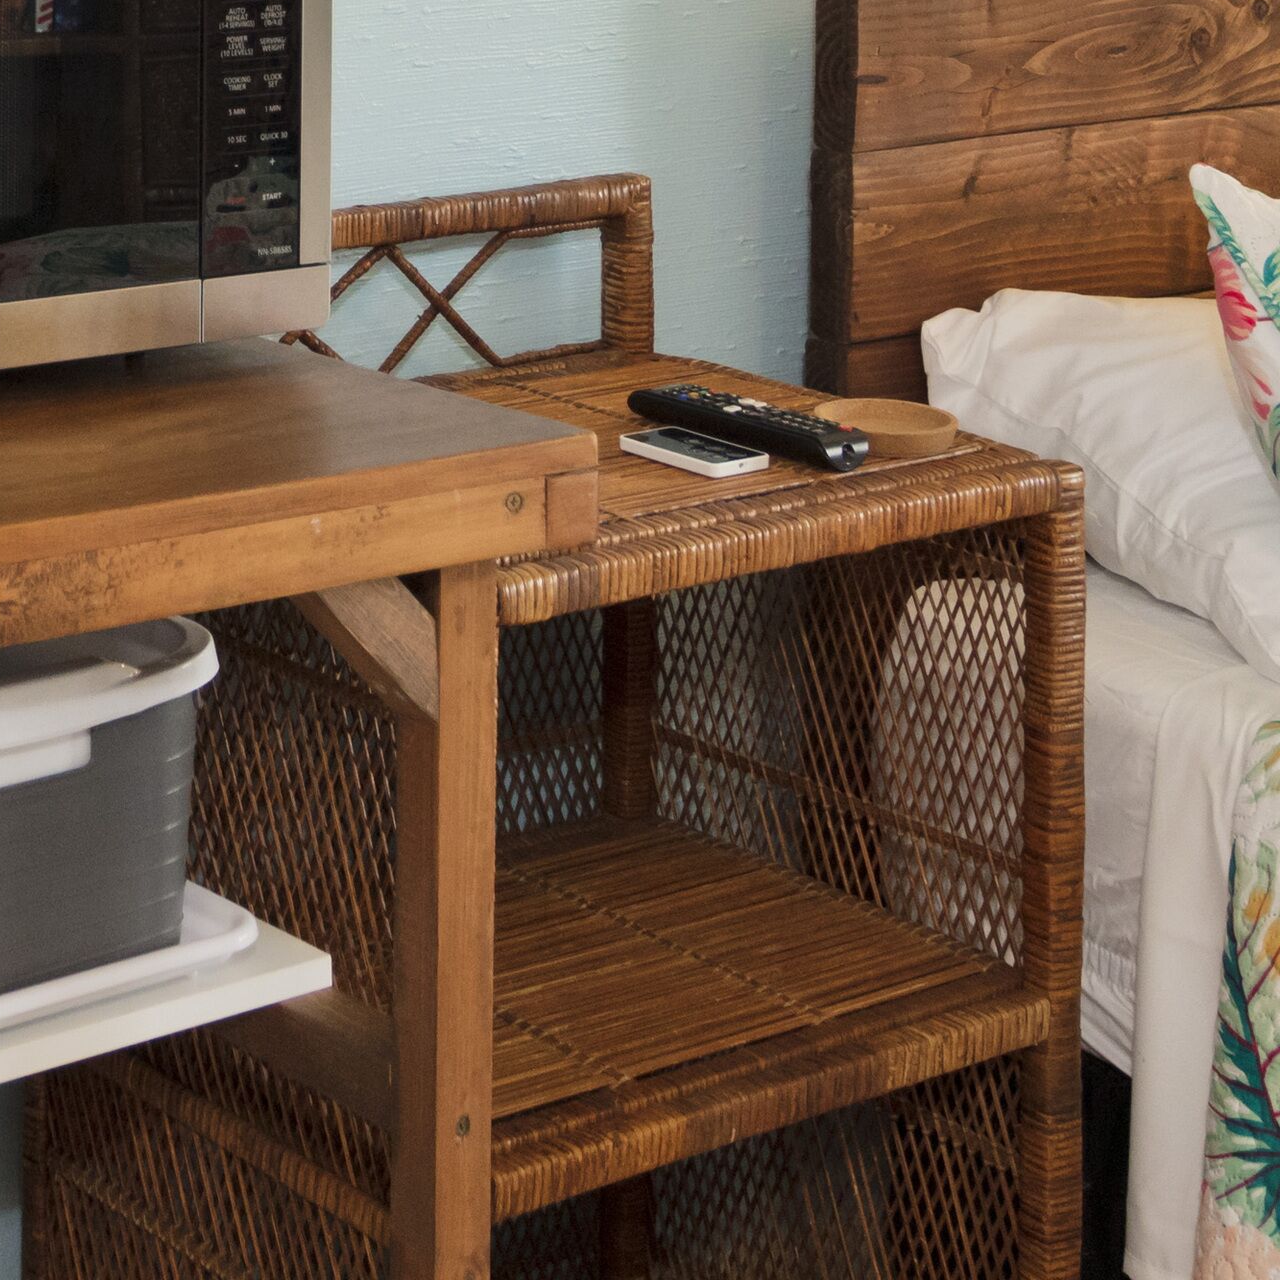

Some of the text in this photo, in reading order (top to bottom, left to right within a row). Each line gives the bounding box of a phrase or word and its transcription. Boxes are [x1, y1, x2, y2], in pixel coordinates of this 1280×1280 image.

[263, 73, 282, 81] CLOCK
[260, 132, 279, 141] QUICK
[262, 192, 282, 200] START
